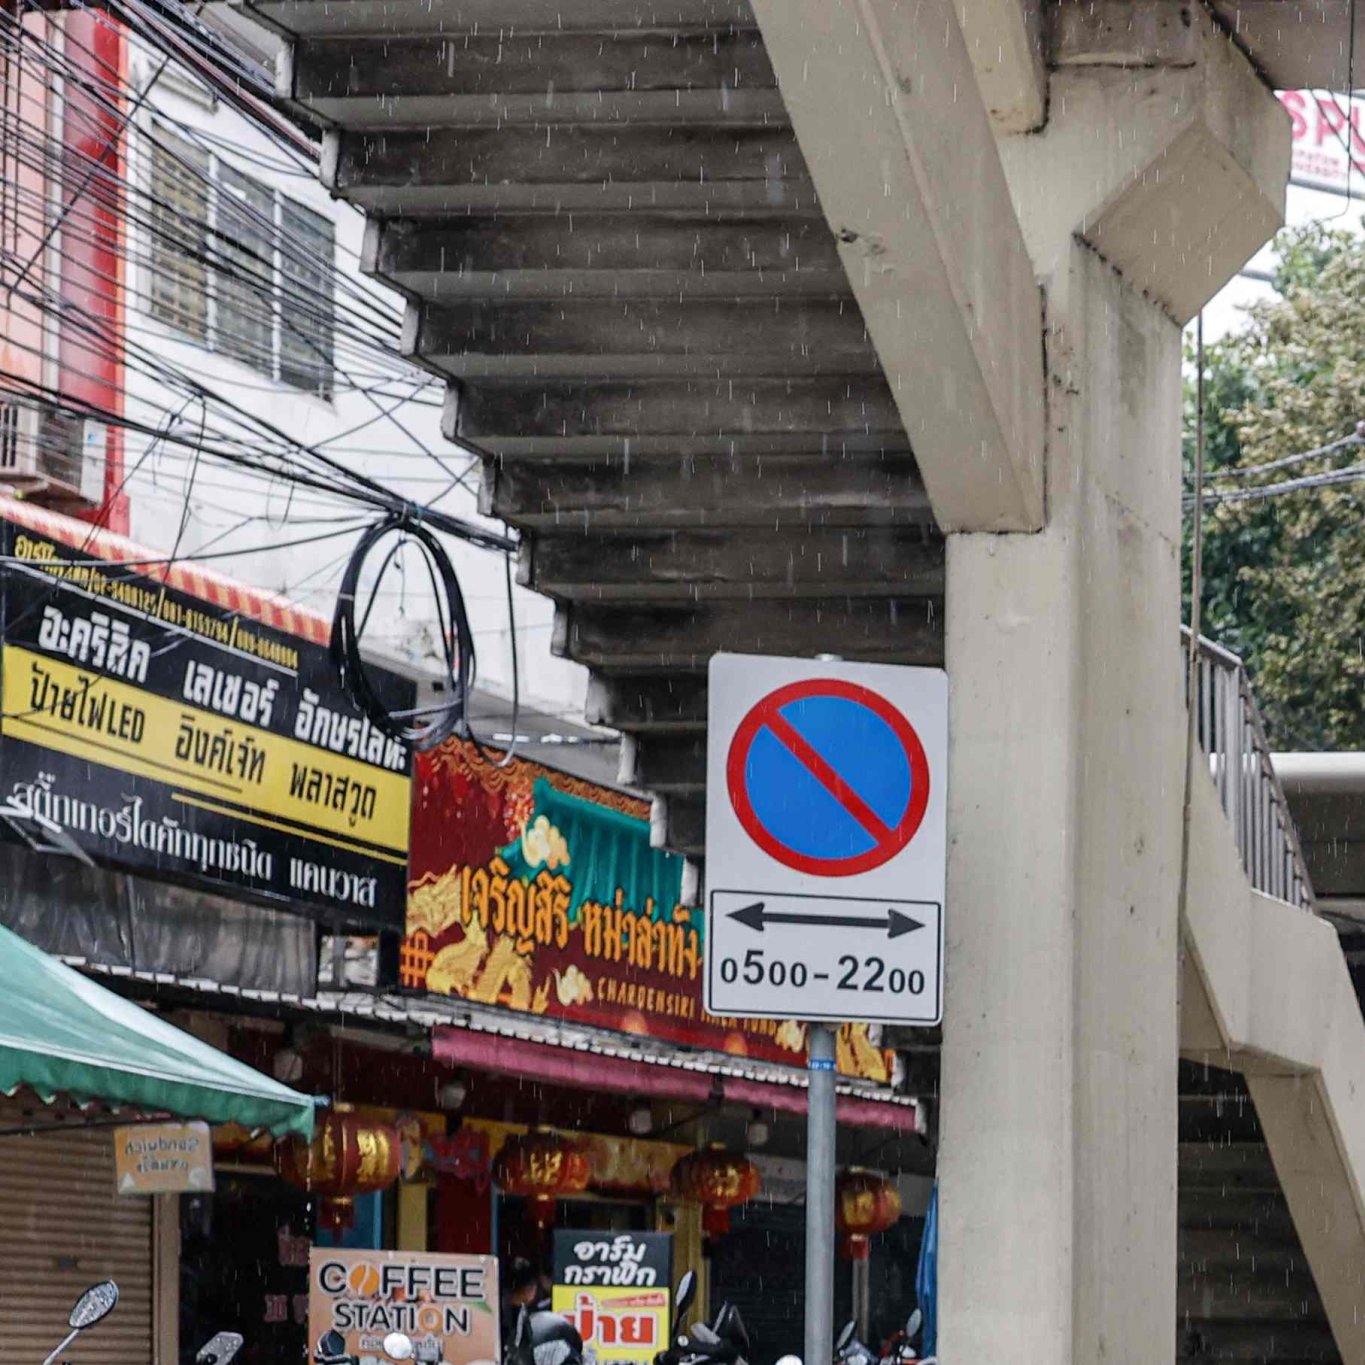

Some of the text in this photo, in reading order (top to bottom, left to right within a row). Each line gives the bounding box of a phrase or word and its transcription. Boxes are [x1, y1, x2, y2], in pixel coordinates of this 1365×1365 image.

[183, 659, 280, 728] เลเซอร์
[289, 762, 377, 827] พลาสวูด
[290, 857, 377, 908] แคนวาส
[335, 1303, 468, 1333] STATION
